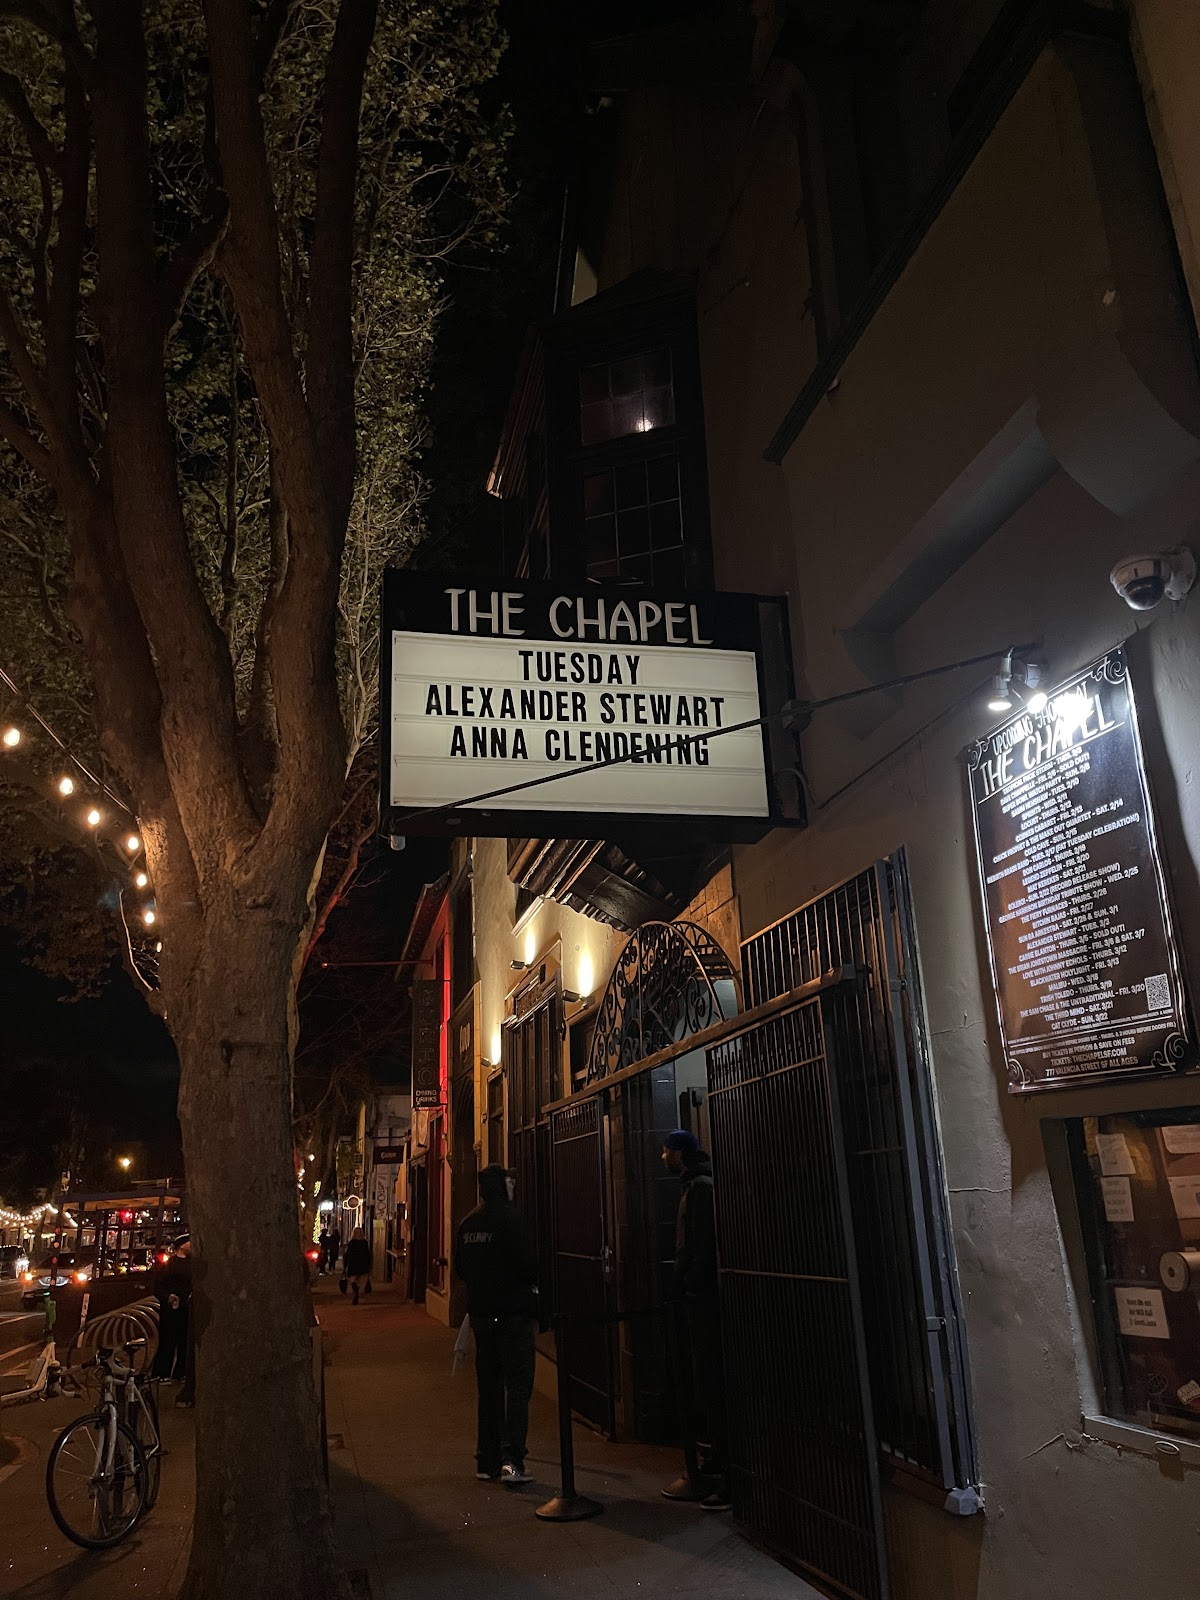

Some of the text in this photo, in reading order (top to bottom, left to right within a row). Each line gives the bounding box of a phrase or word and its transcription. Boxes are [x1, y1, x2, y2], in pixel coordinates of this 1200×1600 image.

[444, 588, 714, 645] THE CHAPEL
[518, 650, 640, 685] TUESDAY
[425, 684, 725, 728] ALEXANDER STEWART
[449, 725, 710, 767] ANNA CLENDENING
[980, 748, 1015, 796] THE
[1083, 877, 1102, 891] SHOW
[1092, 927, 1109, 939] SOLD
